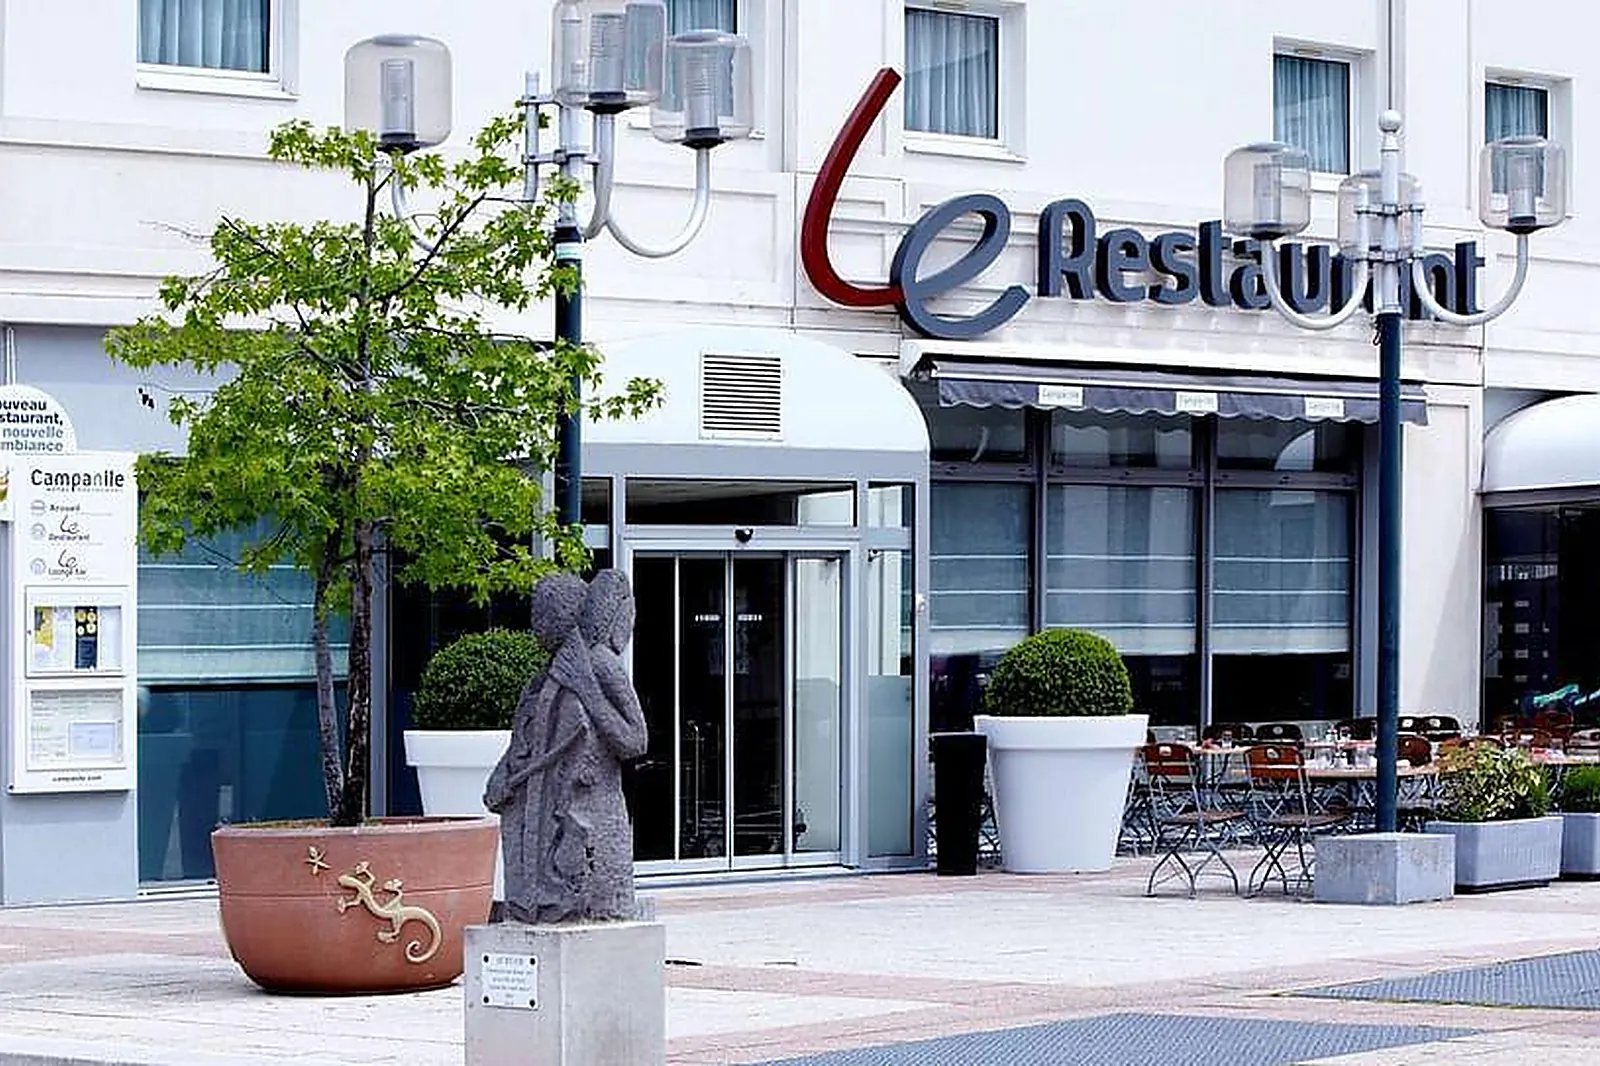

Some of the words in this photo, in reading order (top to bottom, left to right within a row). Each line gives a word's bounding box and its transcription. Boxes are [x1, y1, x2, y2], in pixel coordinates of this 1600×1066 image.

[801, 67, 1031, 340] Le
[0, 400, 47, 411] uveau
[3, 426, 64, 438] nouvelle
[31, 468, 125, 492] Campanile
